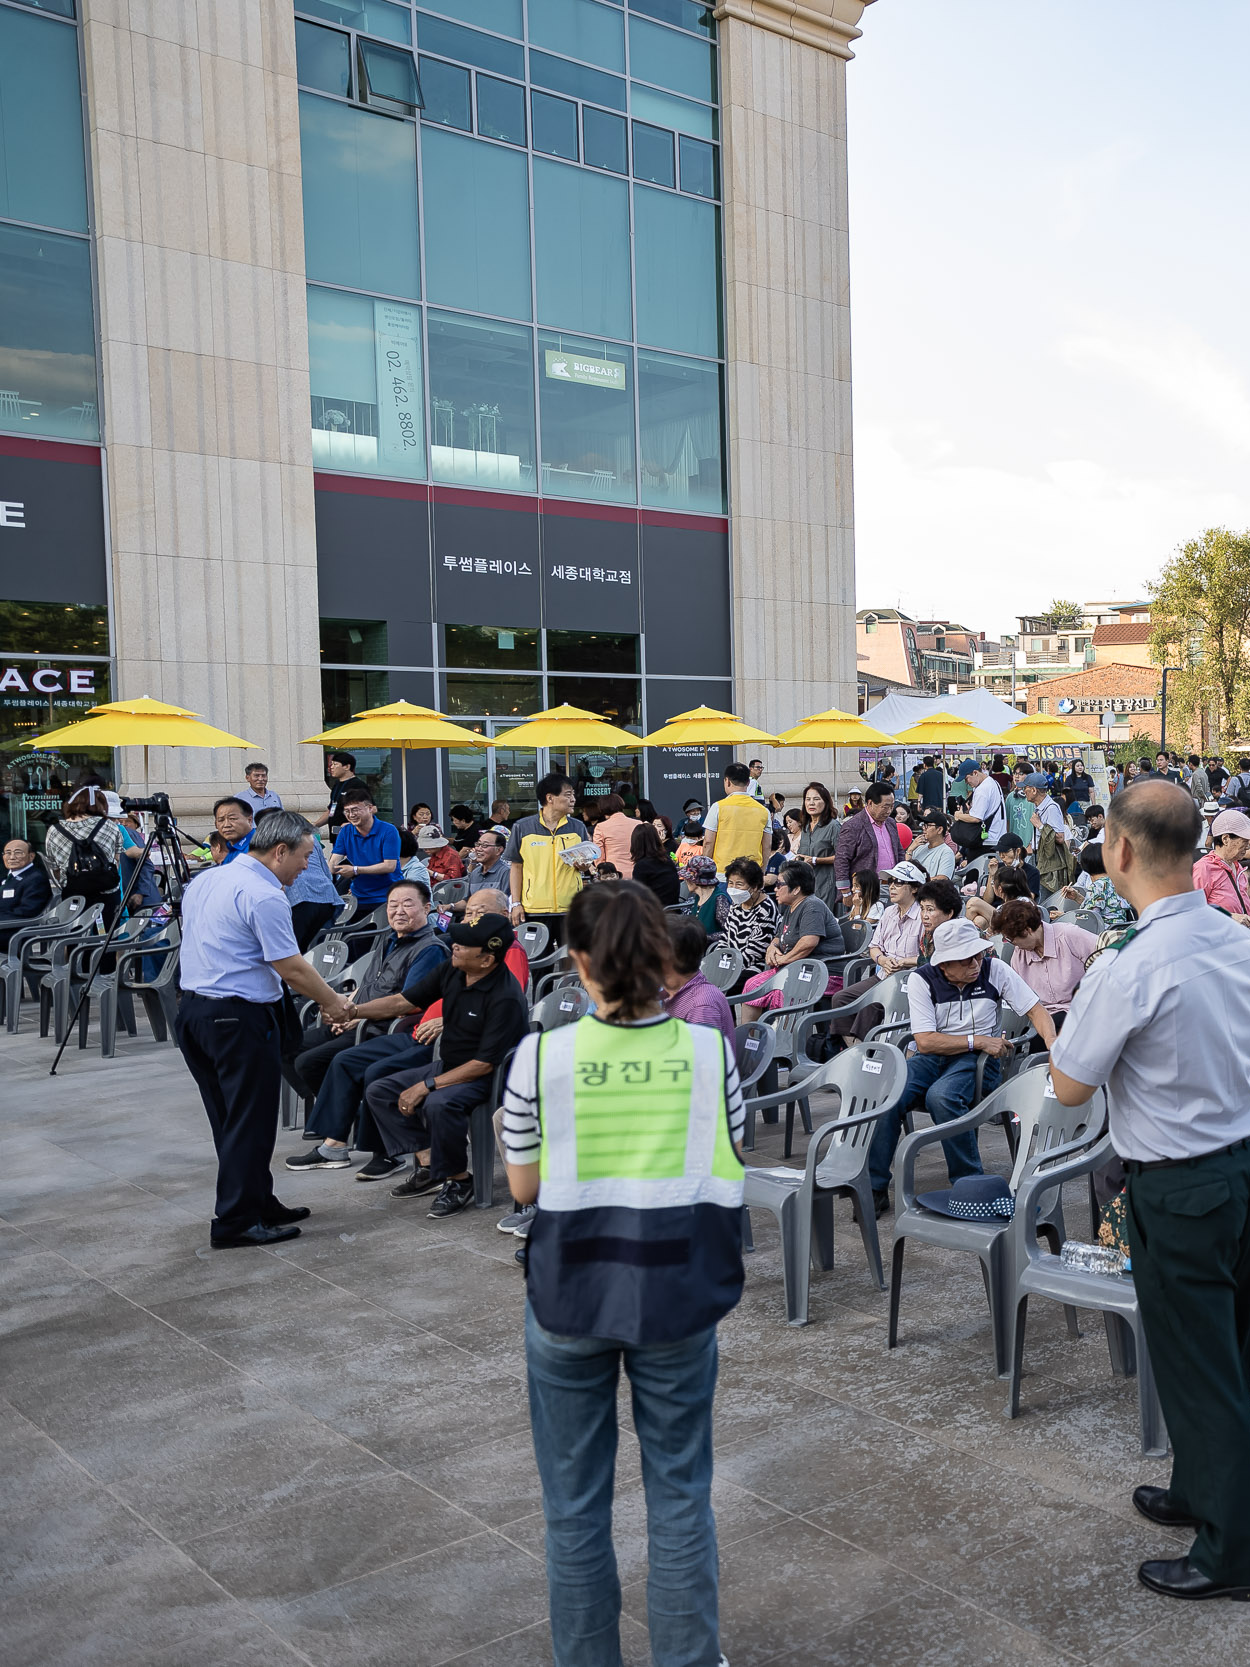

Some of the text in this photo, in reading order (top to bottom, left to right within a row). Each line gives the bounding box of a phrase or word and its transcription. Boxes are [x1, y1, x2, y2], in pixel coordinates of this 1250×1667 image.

[386, 350, 402, 372] 02.
[392, 376, 409, 407] 462.
[398, 412, 417, 451] 8802.
[442, 555, 632, 585] 투썸플레이스 세종대학교점
[3, 699, 98, 708] 투썸플레이스 세종대학교점
[10, 753, 48, 766] TWOSOME
[586, 787, 612, 796] DESSERT
[23, 800, 63, 811] DESSERT
[575, 1059, 692, 1087] 광진구
